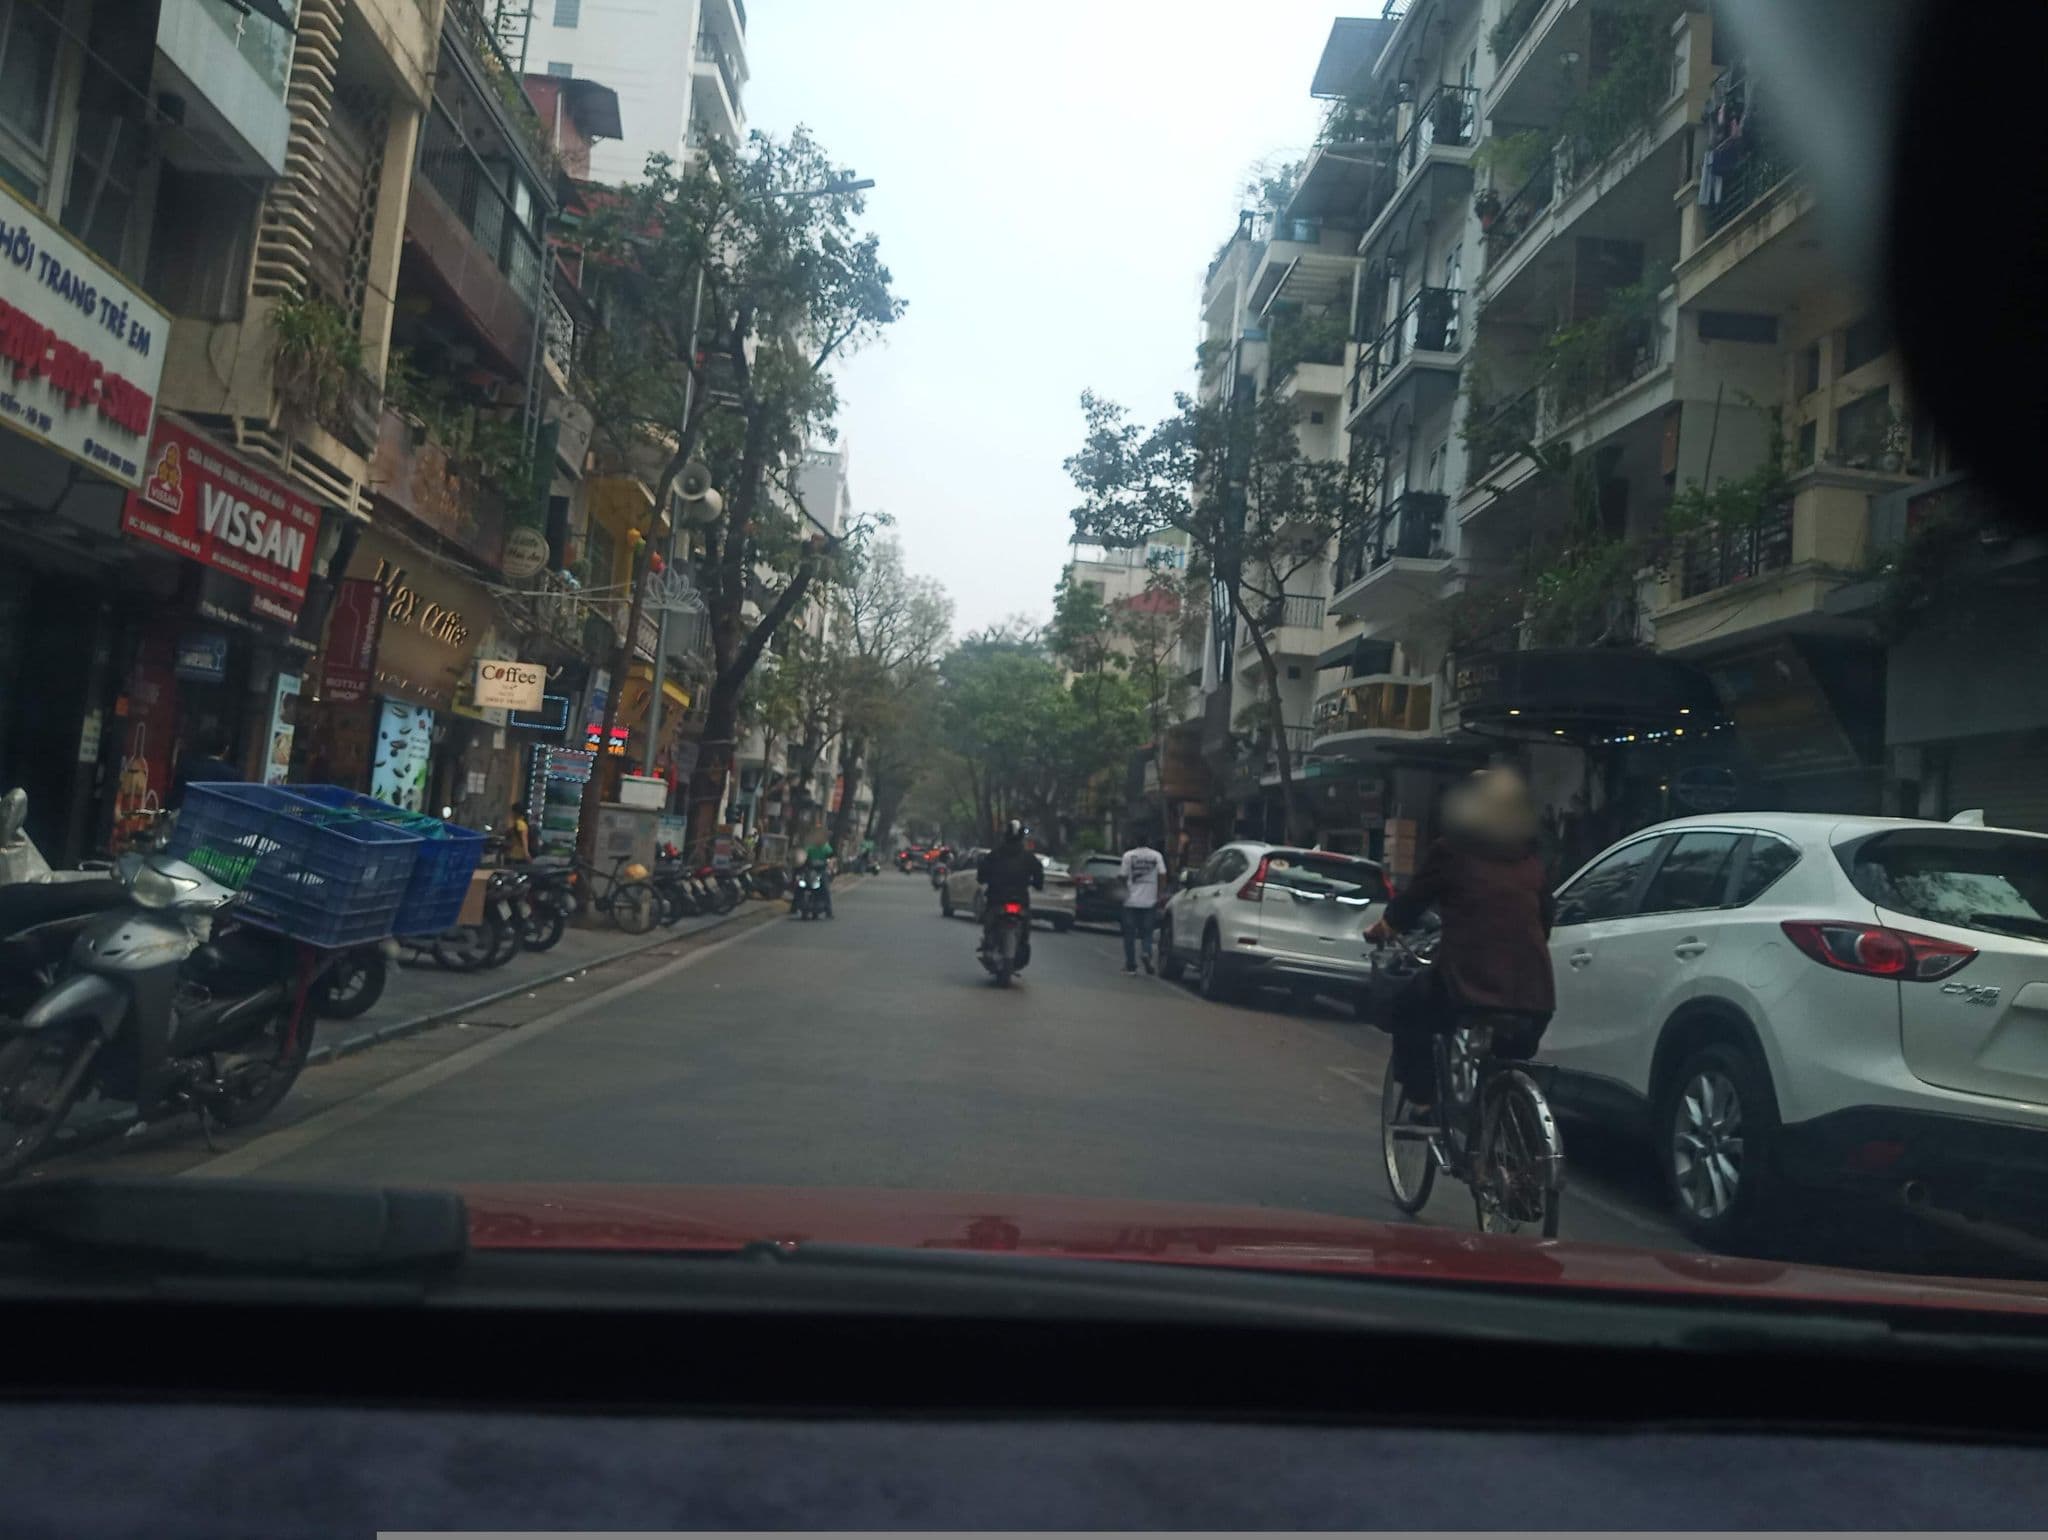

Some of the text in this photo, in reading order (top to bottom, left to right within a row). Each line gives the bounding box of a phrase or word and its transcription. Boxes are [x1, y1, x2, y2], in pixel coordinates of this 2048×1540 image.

[38, 250, 98, 318] TRANG
[99, 296, 129, 340] TRẺ
[128, 319, 151, 358] EM
[204, 481, 306, 573] VISSAN
